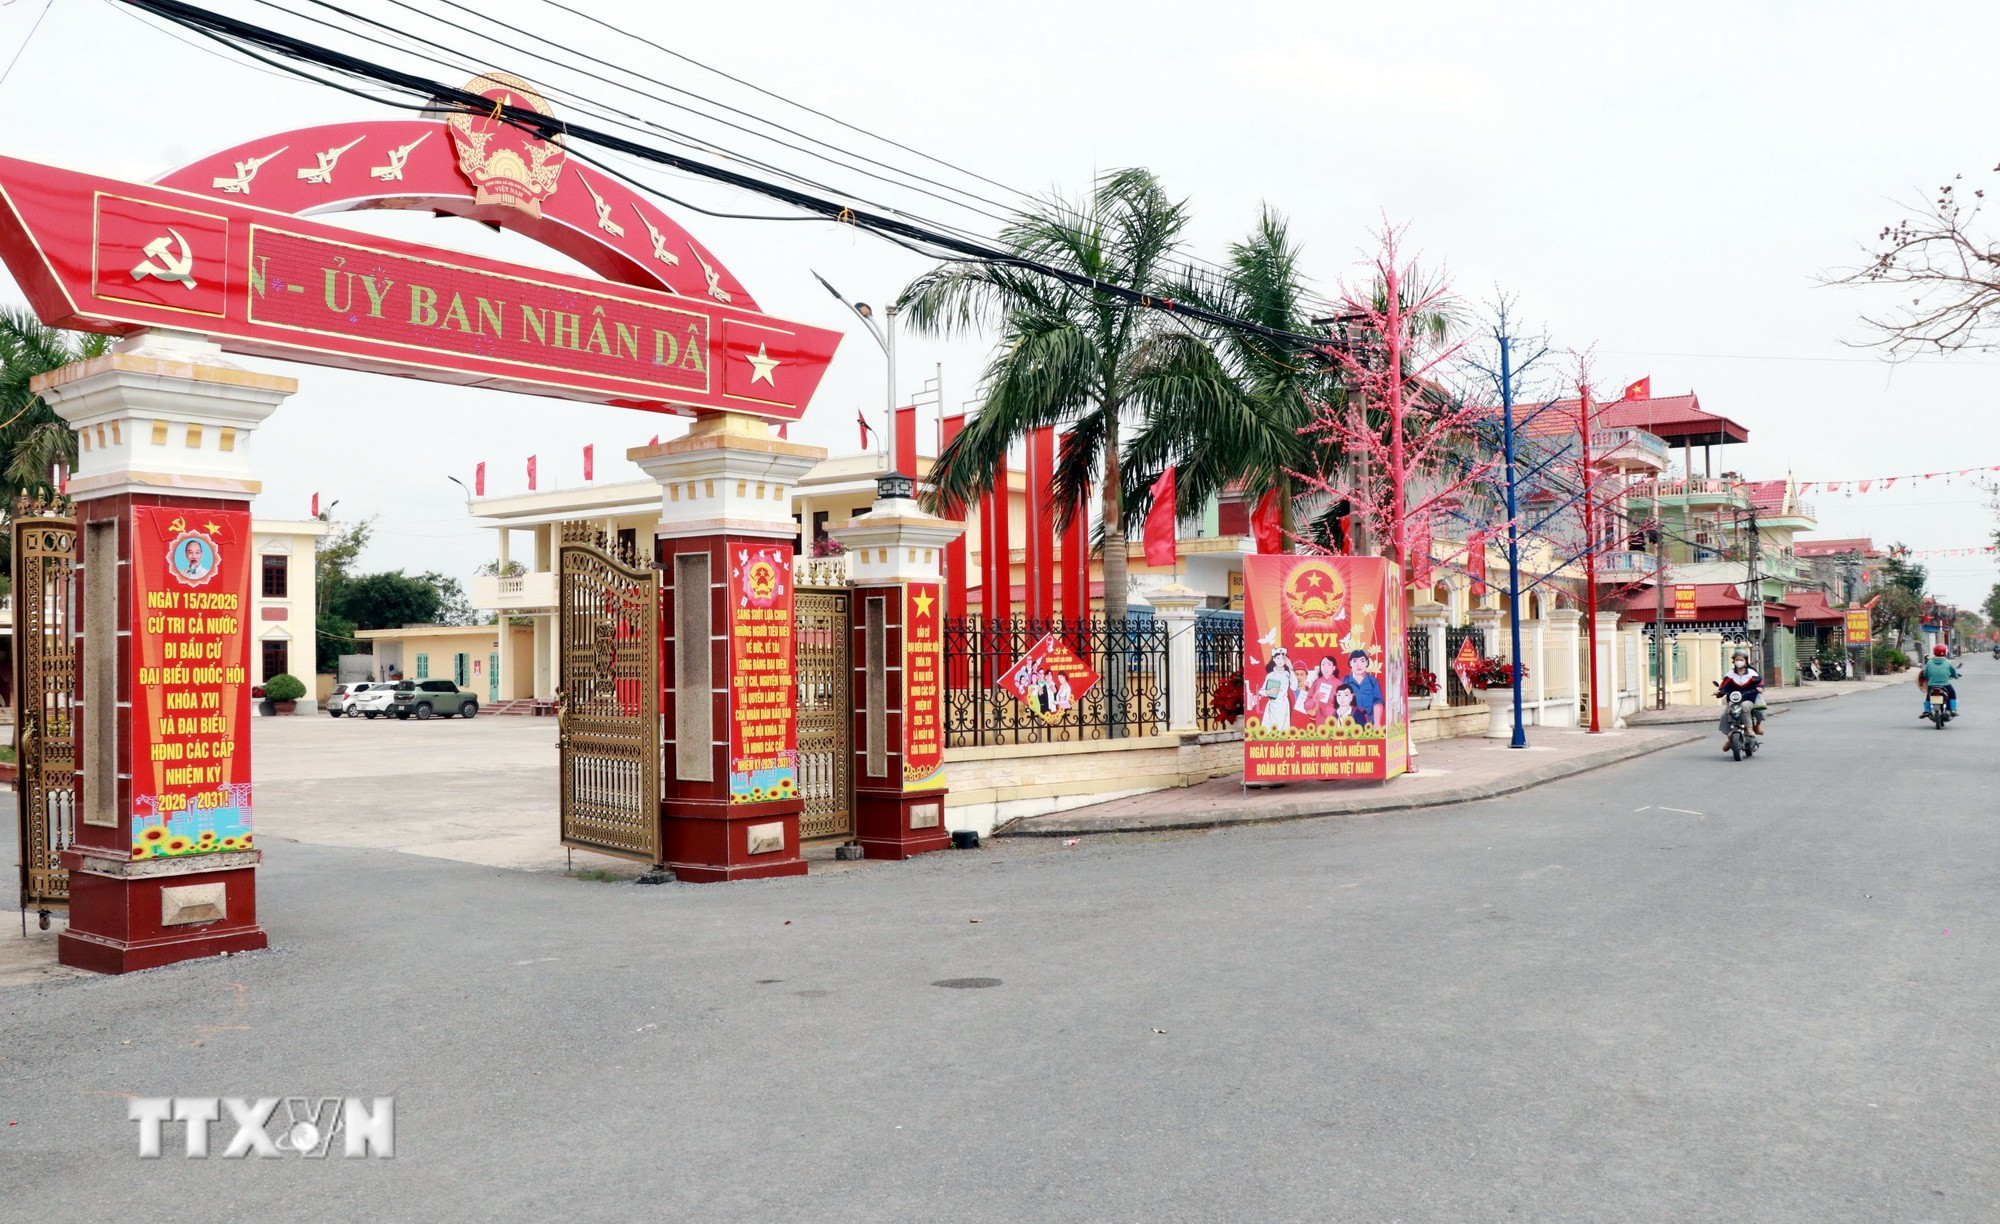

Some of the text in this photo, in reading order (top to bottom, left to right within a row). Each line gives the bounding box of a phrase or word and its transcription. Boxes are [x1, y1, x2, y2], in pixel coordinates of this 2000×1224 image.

[321, 256, 394, 318] ỦY
[407, 284, 506, 339] BAN
[519, 304, 641, 361] NHÂN
[652, 323, 706, 371] DÂ
[148, 589, 238, 610] NGÀY 15/3/2026
[148, 612, 238, 635] CỬ TRI CẢ NƯỚC
[164, 637, 223, 659] ĐI BẦU CỬ
[1295, 633, 1338, 647] XVI
[140, 661, 245, 689] ĐẠI BIỂU QUỐC HỘI
[167, 689, 219, 710] KHÓA XVI
[159, 710, 226, 737] VÀ ĐẠI BIỂU
[151, 733, 234, 761] HĐND CÁC CẤP
[1250, 744, 1268, 758] NGÀY
[1270, 742, 1284, 758] BẦU
[1286, 742, 1296, 758] CỬ
[1301, 744, 1319, 757] NGÀY
[1321, 743, 1332, 760] HỘI
[1334, 742, 1347, 757] CỦA
[1349, 741, 1366, 756] NIỀM
[1368, 745, 1380, 758] TIN,
[166, 763, 221, 787] NHIỆM KỲ
[1257, 761, 1275, 776] ĐOÀN
[1277, 760, 1290, 775] KẾT
[1291, 761, 1300, 775] VÀ
[1302, 761, 1319, 775] KHÁT
[1321, 763, 1338, 777] VỌNG
[1340, 760, 1354, 776] VIỆT
[158, 793, 186, 811] 2026
